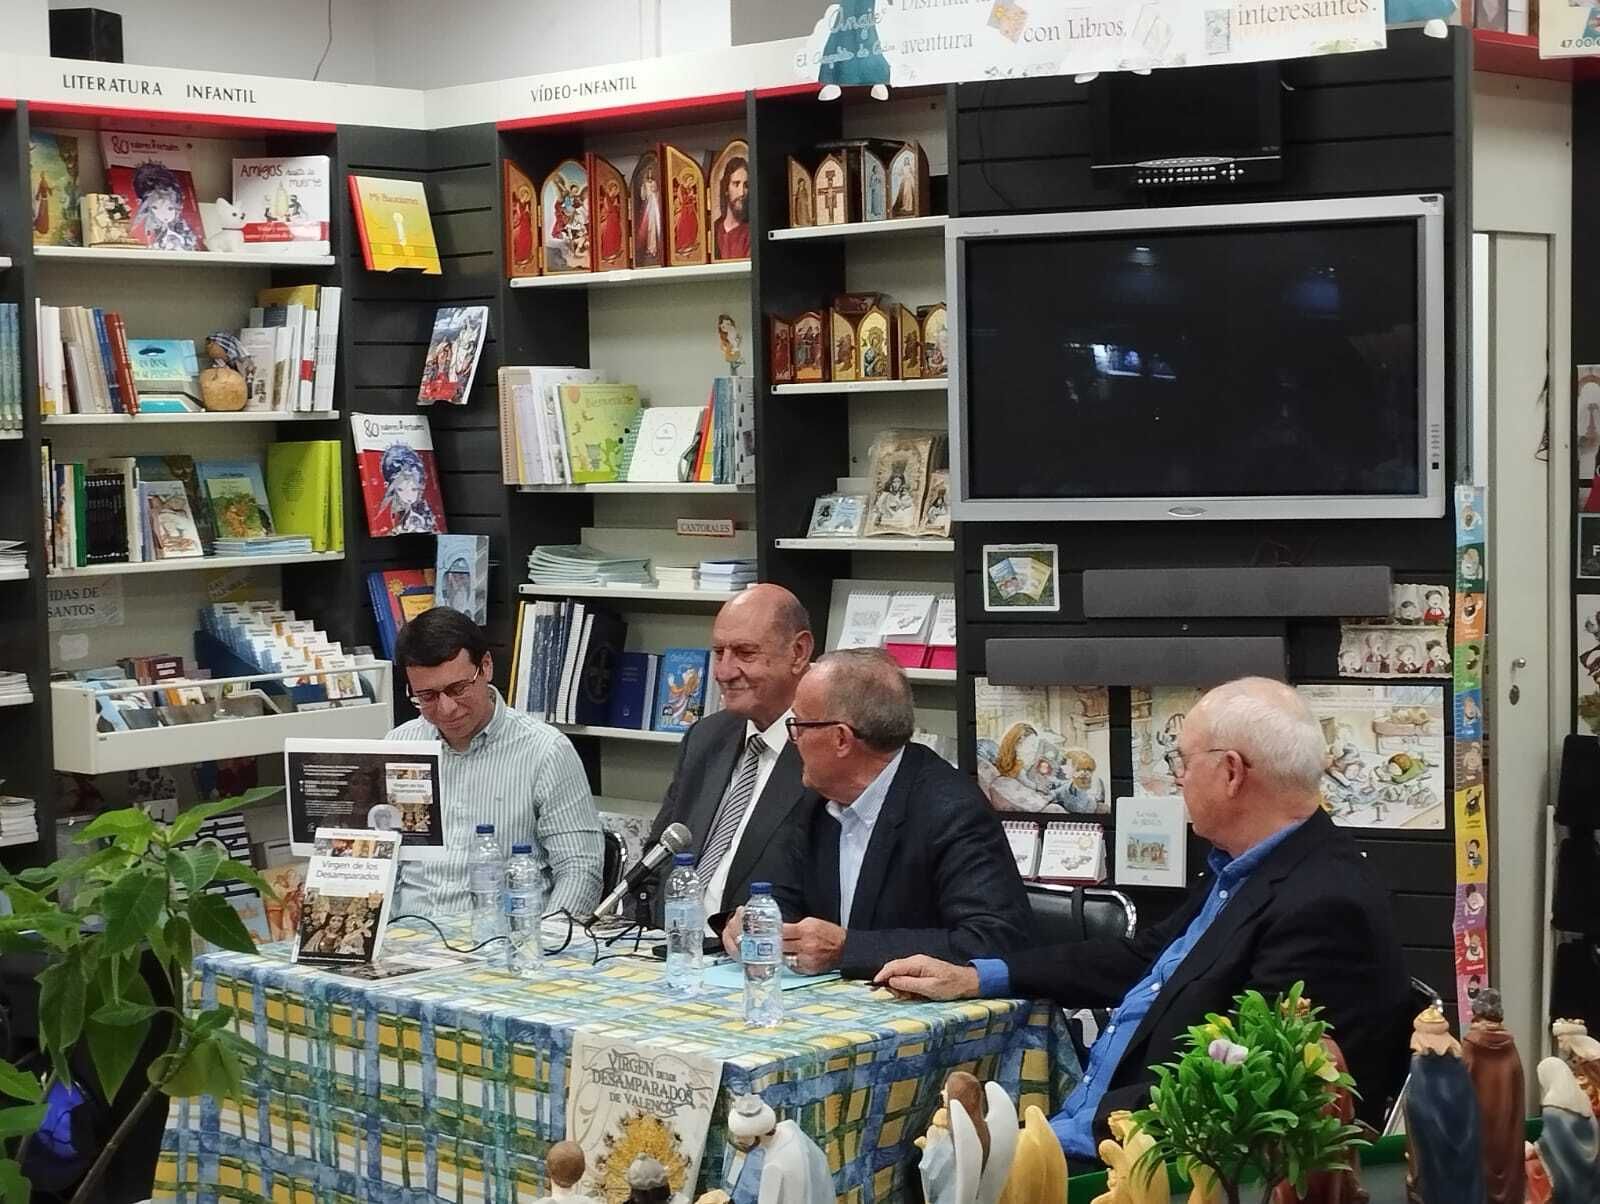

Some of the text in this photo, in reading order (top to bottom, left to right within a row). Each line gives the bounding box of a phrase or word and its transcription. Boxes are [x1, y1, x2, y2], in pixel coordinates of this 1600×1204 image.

[1023, 25, 1060, 43] con
[901, 32, 974, 55] aventura
[62, 73, 257, 104] LITERATURA INFANTIL
[529, 75, 638, 103] VÍDEO-INFANTIL
[240, 164, 284, 180] Amigos
[680, 522, 730, 533] CANTORALES
[82, 586, 100, 599] DE
[48, 604, 95, 618] SANTOS
[321, 860, 378, 871] Virgen de los
[315, 870, 380, 881] Desamparados
[608, 1049, 654, 1077] VIRGEN
[592, 1068, 694, 1106] DESAMPARADOS
[608, 1091, 622, 1104] DE
